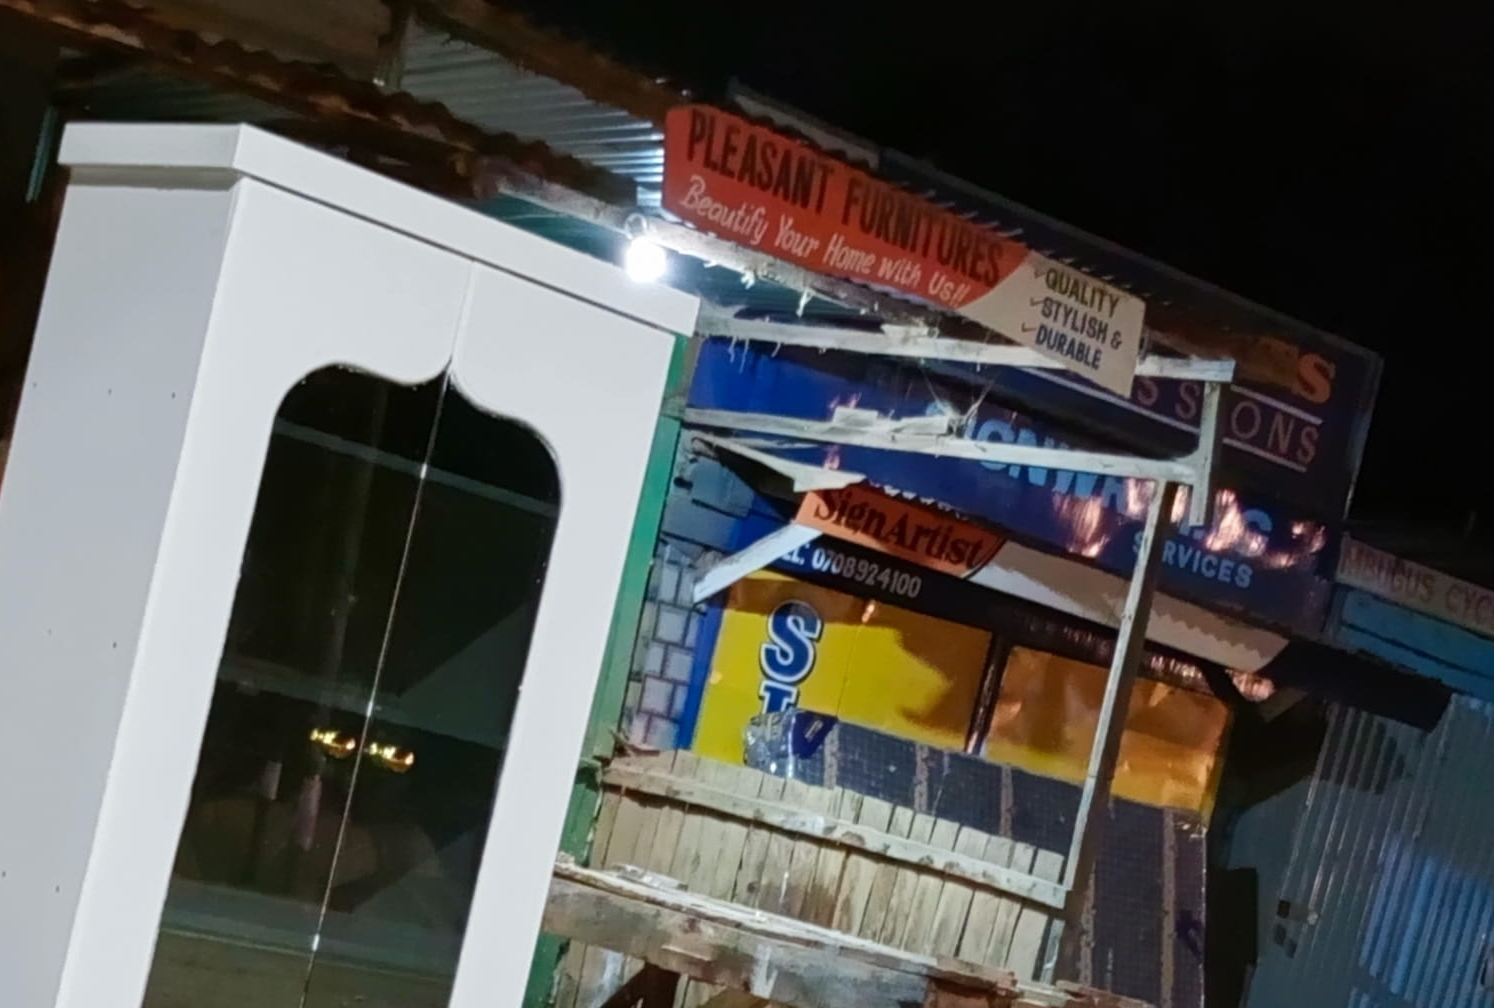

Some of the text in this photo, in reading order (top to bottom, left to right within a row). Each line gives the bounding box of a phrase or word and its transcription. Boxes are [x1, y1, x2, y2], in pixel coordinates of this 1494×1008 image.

[686, 108, 1004, 285] PLEASANT FURNITURES
[679, 174, 972, 308] Beautify Your Home with Us!!
[1045, 267, 1120, 318] QUALITY
[1035, 325, 1103, 371] DURABLE
[1041, 296, 1123, 350] STYLISH &
[811, 547, 923, 599] 0708924100
[1132, 529, 1253, 588] SRVICES
